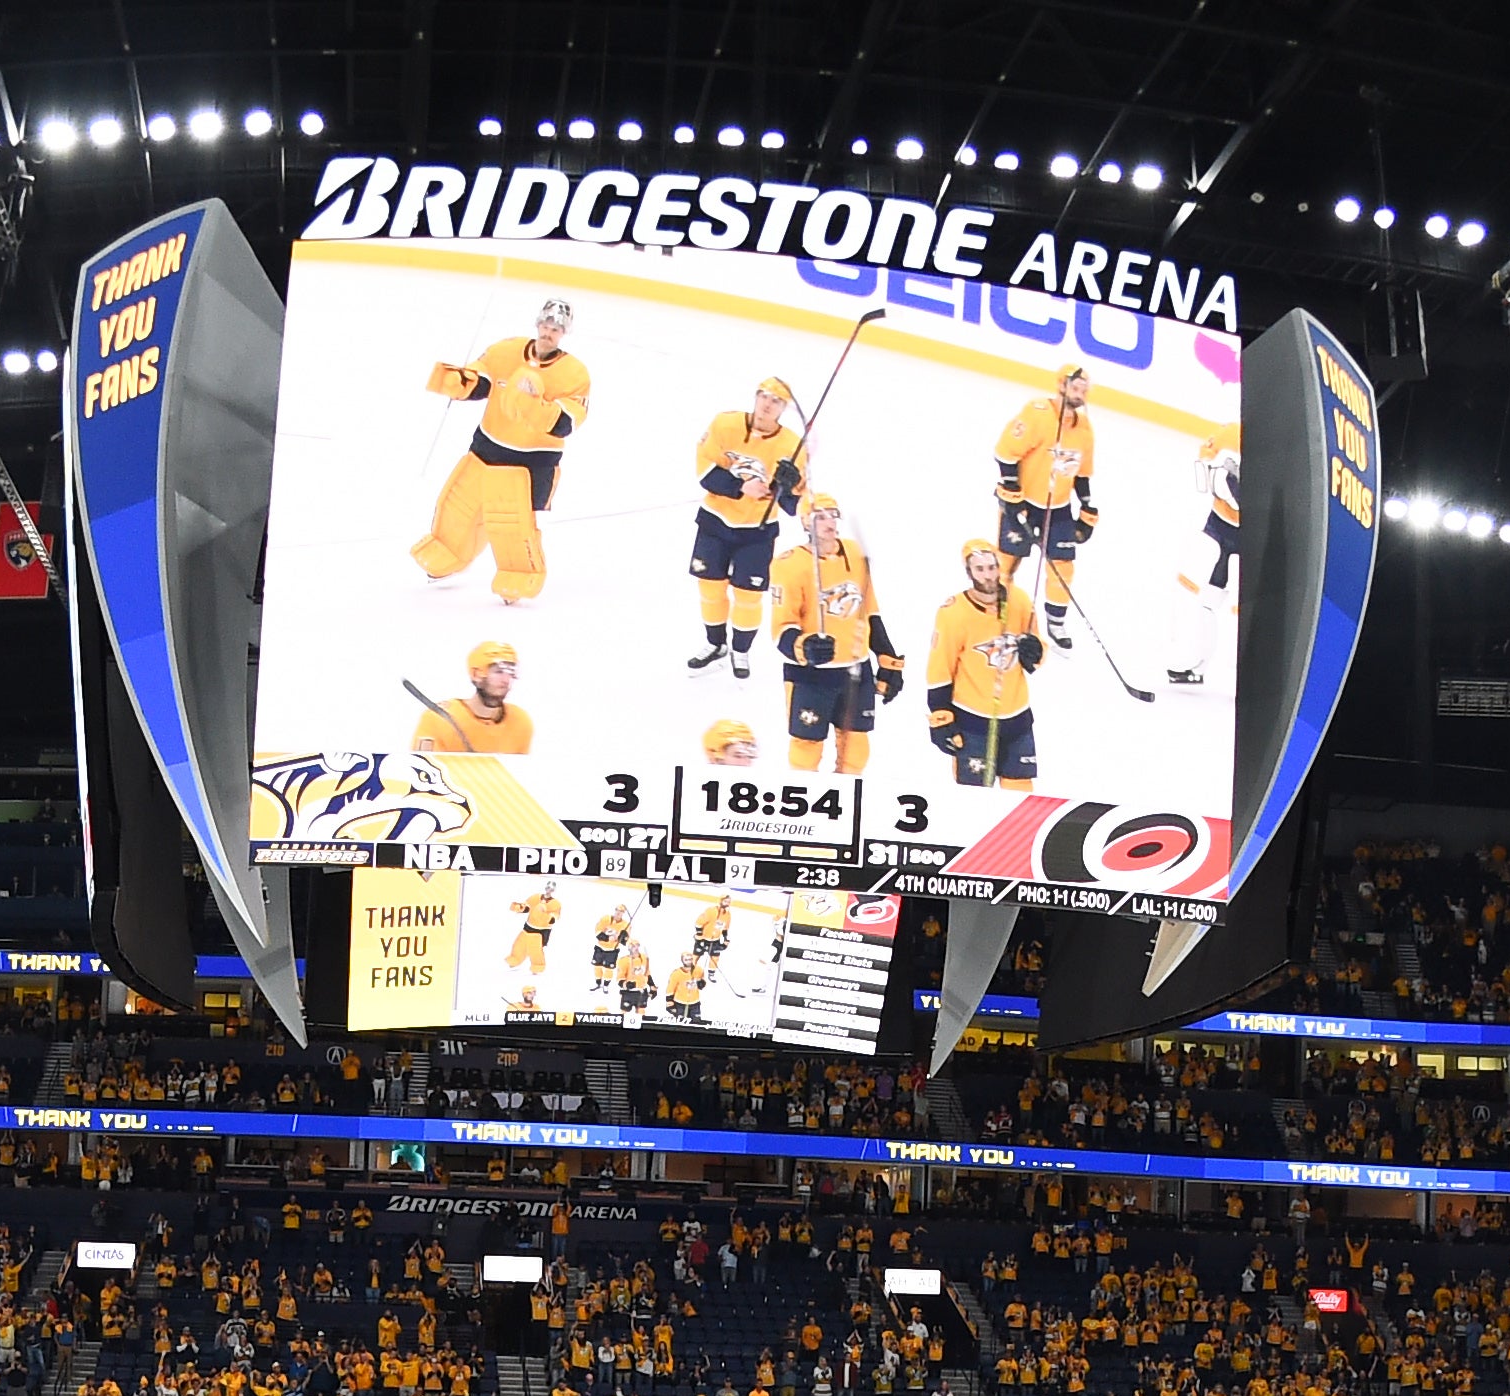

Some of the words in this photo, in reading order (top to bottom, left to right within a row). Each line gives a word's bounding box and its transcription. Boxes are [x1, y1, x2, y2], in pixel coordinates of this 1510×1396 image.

[300, 155, 996, 278] BRIDGESTONE
[1008, 232, 1240, 333] ARENA
[92, 231, 188, 312] THANK
[98, 297, 157, 359] YOU
[84, 346, 160, 420] FANS
[1314, 343, 1373, 434] THANK
[1332, 406, 1369, 474] YOU
[1329, 465, 1374, 531] FANS
[602, 773, 640, 814] 3
[701, 779, 844, 821] 18:54
[895, 794, 929, 833] 3
[627, 827, 668, 850] 27
[719, 818, 816, 838] BRIDGESTONE
[403, 842, 476, 872] NBA
[517, 847, 590, 876] PHO
[604, 856, 627, 874] 89
[646, 854, 712, 884] LAL
[729, 862, 751, 881] 97
[796, 866, 840, 887] 2:38
[894, 875, 924, 895] 4TH
[926, 876, 995, 899] QUARTER
[1017, 885, 1050, 905] PHO:
[1070, 889, 1111, 911] (.500)
[365, 904, 446, 930] THANK
[1132, 896, 1160, 916] LAL:
[1178, 900, 1218, 924] (.500)
[380, 936, 428, 959] YOU
[7, 953, 81, 972] THANK
[370, 964, 434, 990] FANS
[1226, 1013, 1296, 1033] THANK
[14, 1108, 91, 1129] THANK
[99, 1113, 147, 1129] YOU
[451, 1122, 531, 1142] THANK
[539, 1127, 589, 1145] YOU
[885, 1142, 961, 1162] THANK
[969, 1148, 1014, 1166] YOU
[1287, 1163, 1360, 1183] THANK
[1367, 1169, 1410, 1186] YOU
[387, 1194, 561, 1217] BRIDGESONE
[568, 1204, 638, 1221] ARENA
[84, 1246, 125, 1261] CINTAS
